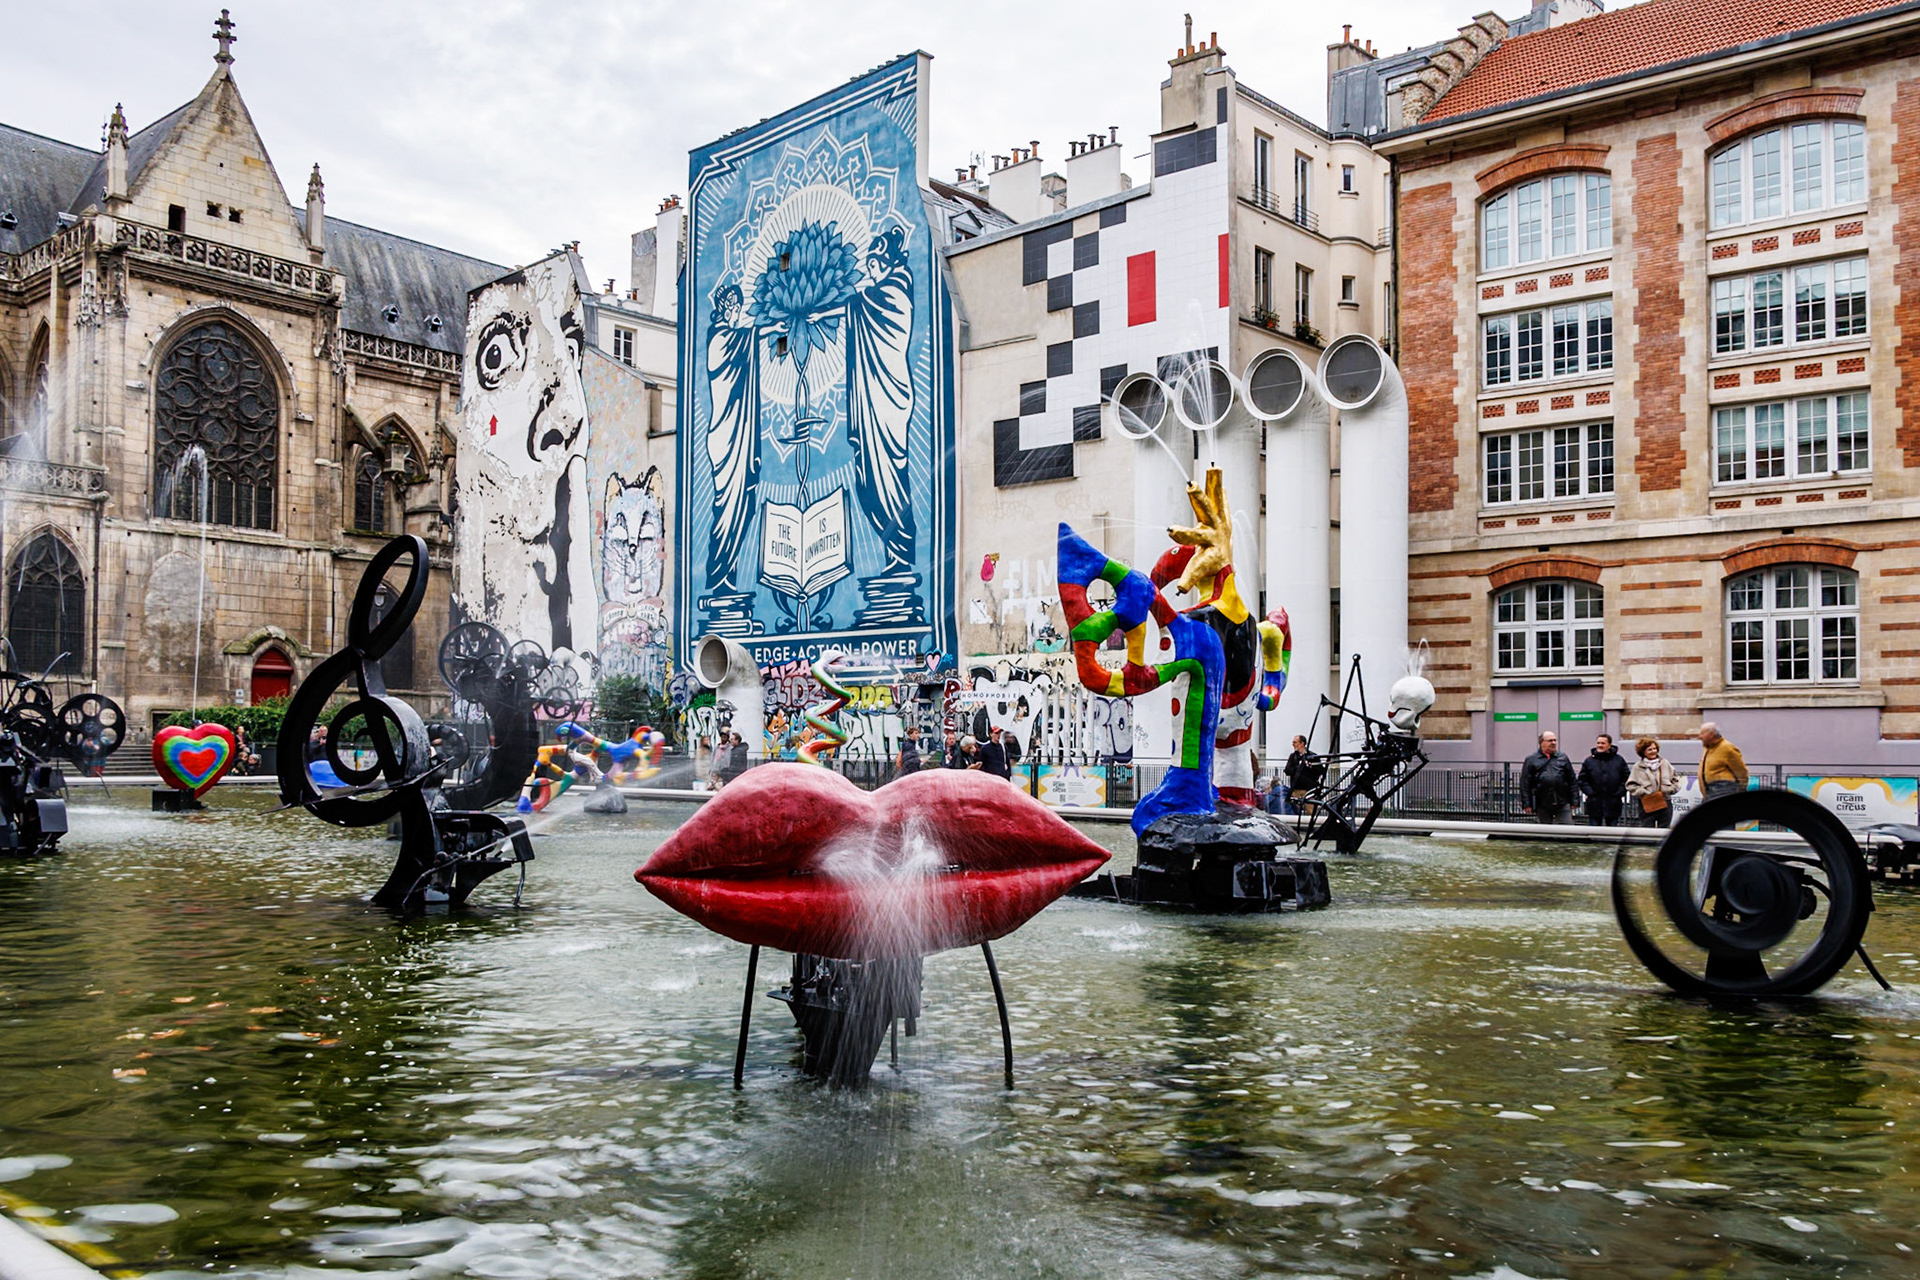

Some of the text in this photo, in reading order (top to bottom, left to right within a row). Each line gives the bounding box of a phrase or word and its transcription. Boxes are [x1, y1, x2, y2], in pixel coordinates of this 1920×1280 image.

[778, 523, 791, 541] THE
[818, 517, 827, 534] IS
[771, 540, 797, 563] FUTURE
[804, 530, 841, 563] UNWRITTEN
[1836, 803, 1866, 811] circus
